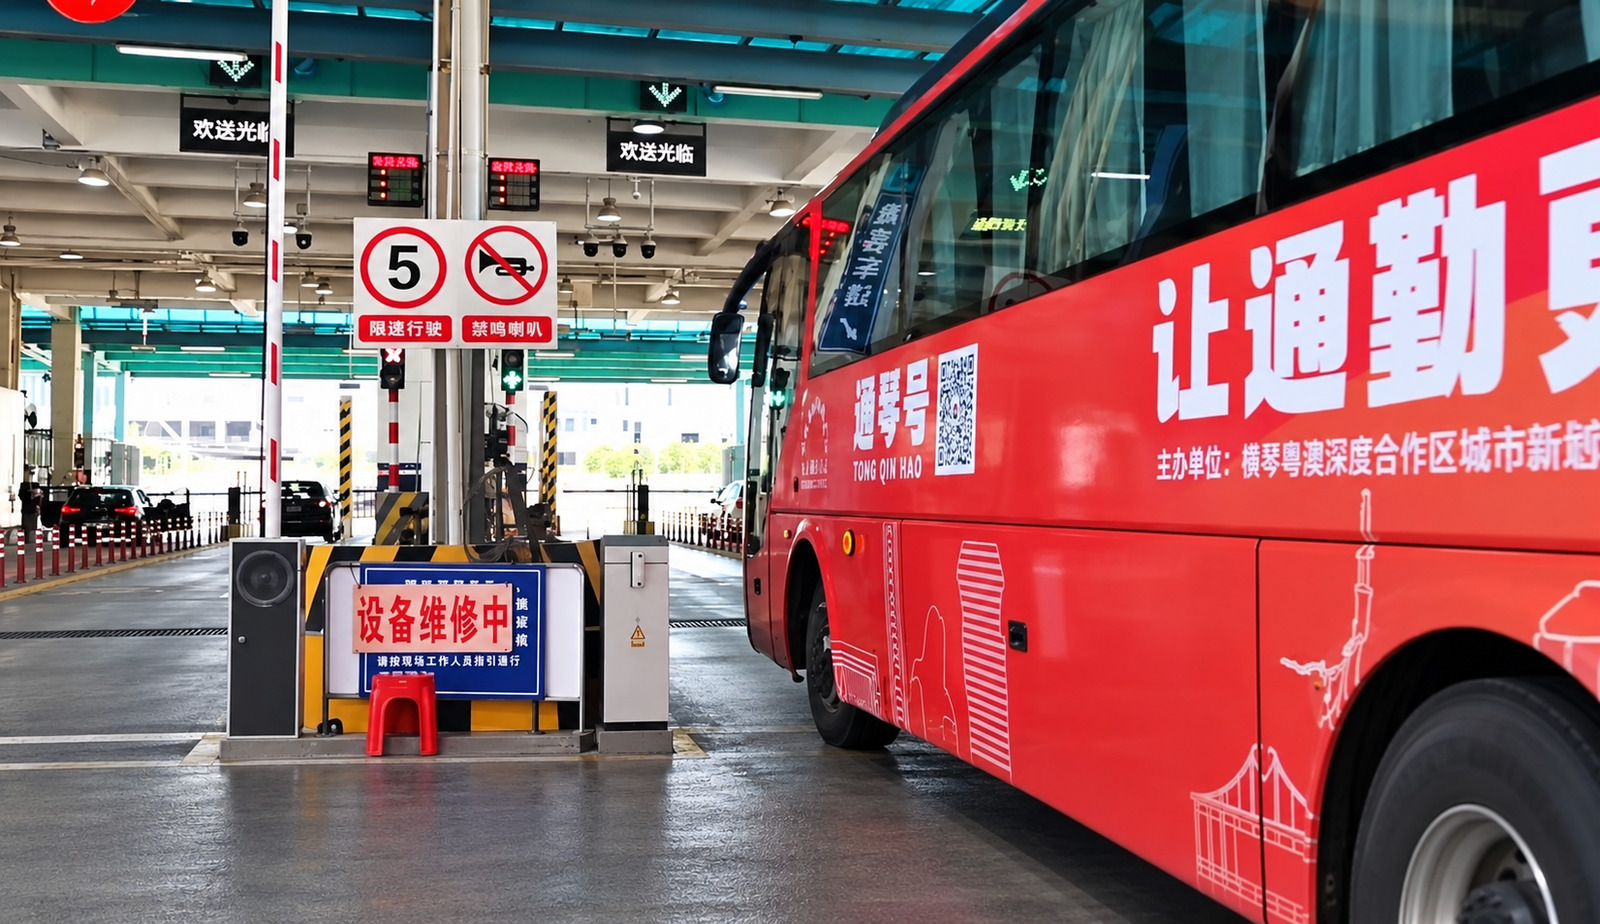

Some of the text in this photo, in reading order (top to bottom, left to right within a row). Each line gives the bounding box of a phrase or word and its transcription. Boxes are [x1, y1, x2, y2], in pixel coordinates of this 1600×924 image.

[620, 141, 694, 164] 欢送光临
[388, 245, 421, 290] 5
[369, 320, 442, 337] 限速行驶
[472, 321, 543, 338] 禁鸣喇叭
[853, 358, 930, 451] 通琴号
[853, 458, 876, 482] TONG
[879, 456, 897, 485] QIN
[900, 454, 922, 480] HAO
[357, 594, 508, 644] 设备维修中
[377, 655, 520, 667] 请按现场工作人员指引通行
